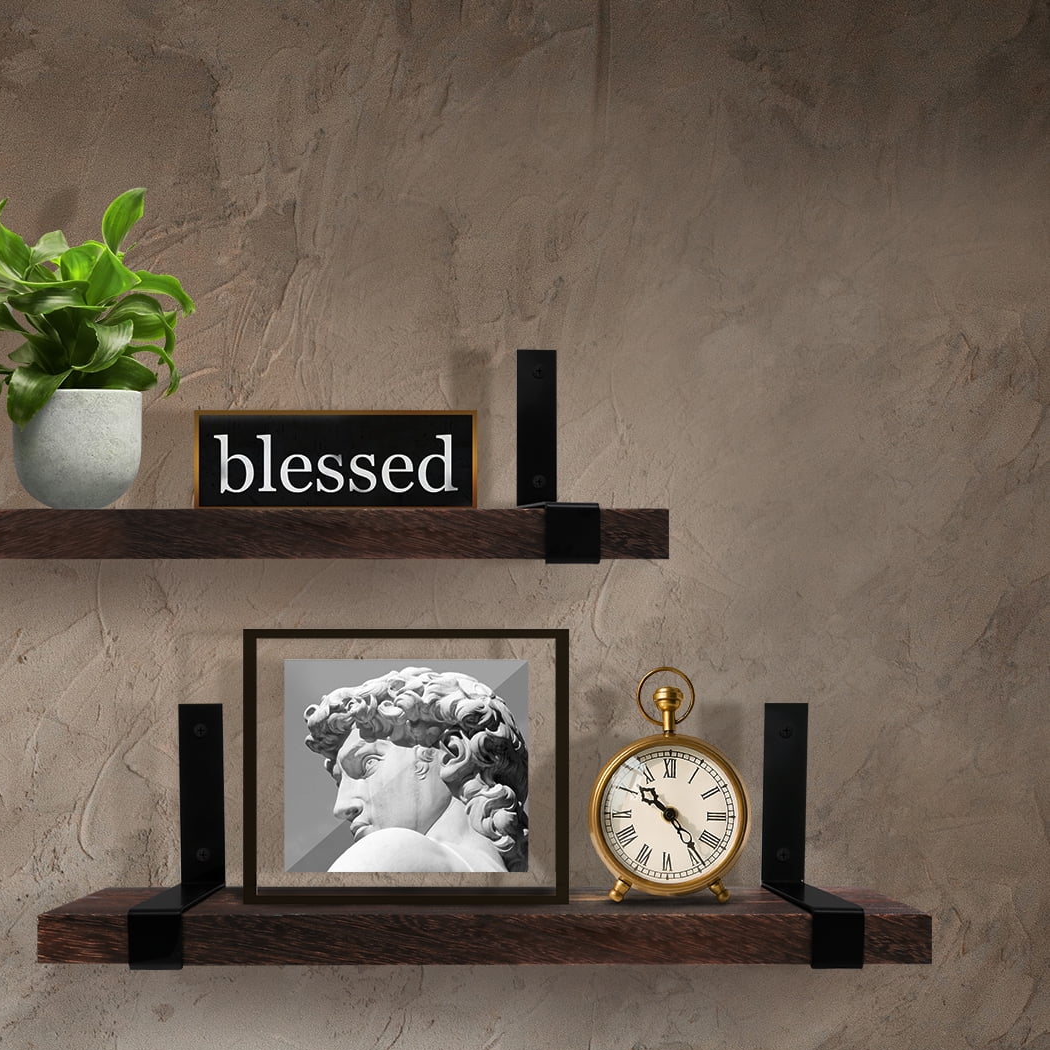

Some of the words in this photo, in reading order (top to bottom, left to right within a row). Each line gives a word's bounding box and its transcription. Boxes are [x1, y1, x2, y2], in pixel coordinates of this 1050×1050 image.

[213, 434, 459, 494] blessed
[663, 758, 677, 778] XII
[688, 767, 700, 784] I
[701, 786, 721, 800] II
[706, 811, 727, 821] III
[615, 824, 639, 848] VIII
[635, 843, 654, 866] VII
[662, 851, 672, 871] VI
